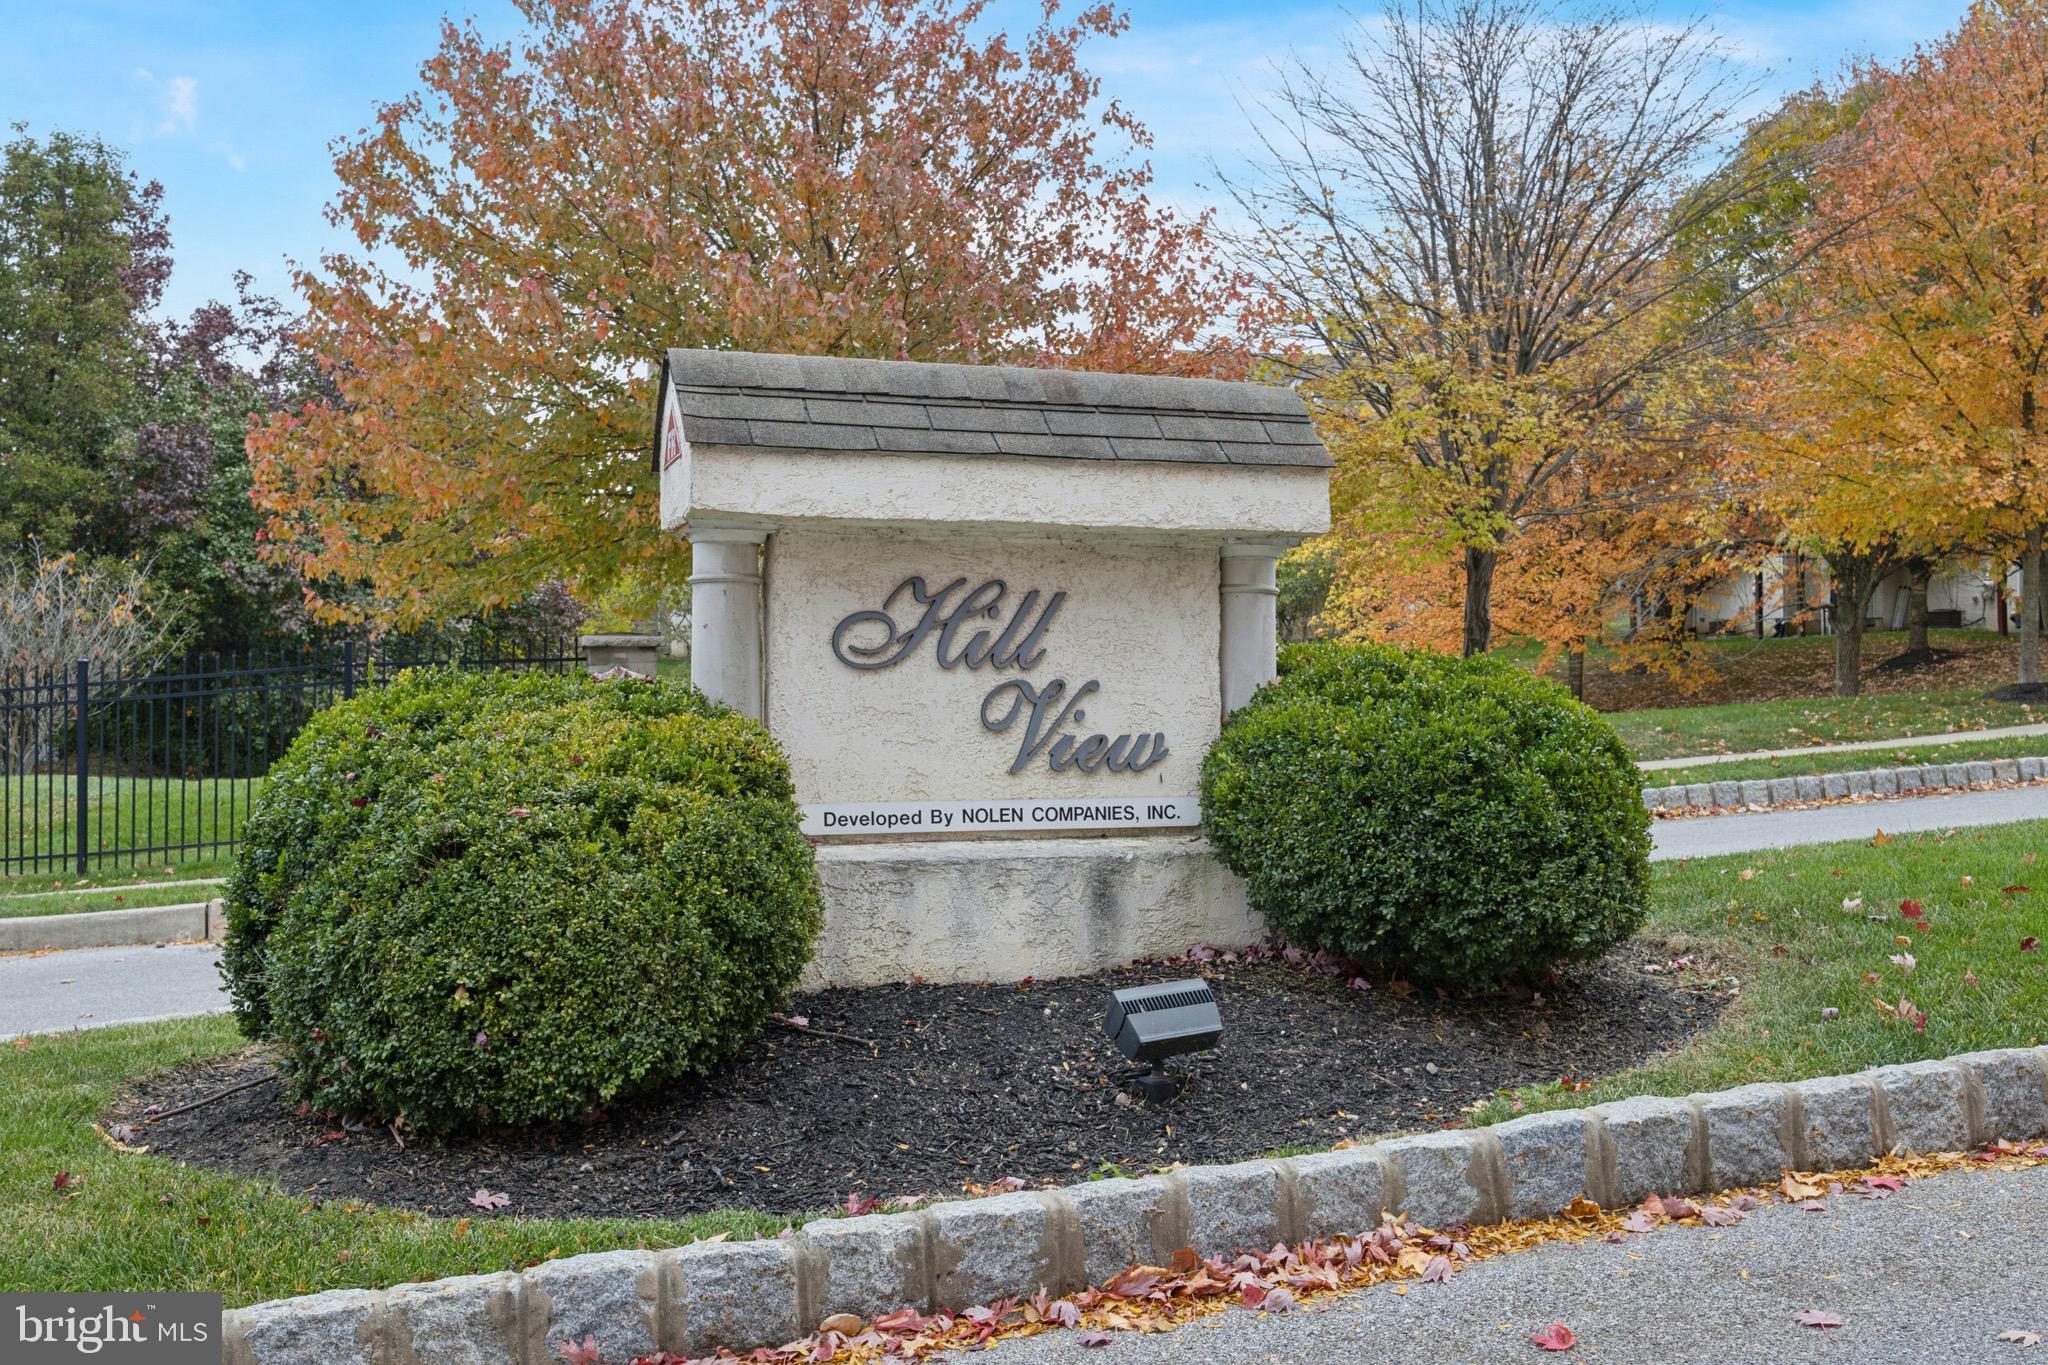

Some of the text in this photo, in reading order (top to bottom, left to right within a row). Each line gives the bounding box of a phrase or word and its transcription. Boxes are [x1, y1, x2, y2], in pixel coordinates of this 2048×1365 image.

[831, 575, 1069, 671] Hill
[980, 678, 1170, 775] View
[823, 804, 1181, 830] Developed By NOLEN COMPANIES, INC.
